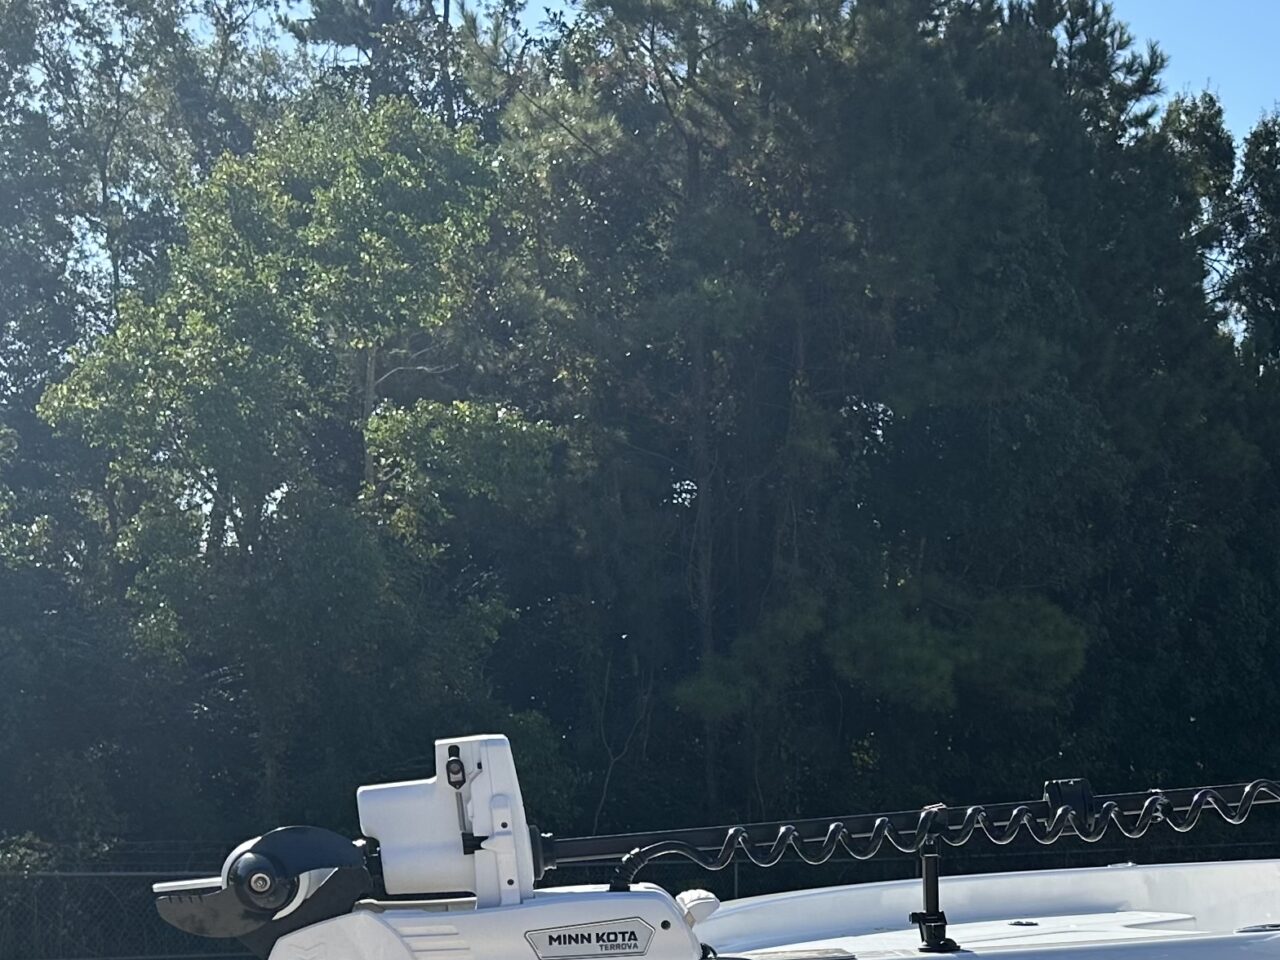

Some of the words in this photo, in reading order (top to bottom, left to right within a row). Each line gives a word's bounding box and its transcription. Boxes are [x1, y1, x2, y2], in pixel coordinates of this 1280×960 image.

[548, 933, 592, 946] MINN
[596, 931, 639, 943] KOTA
[600, 943, 639, 951] TERROVA
